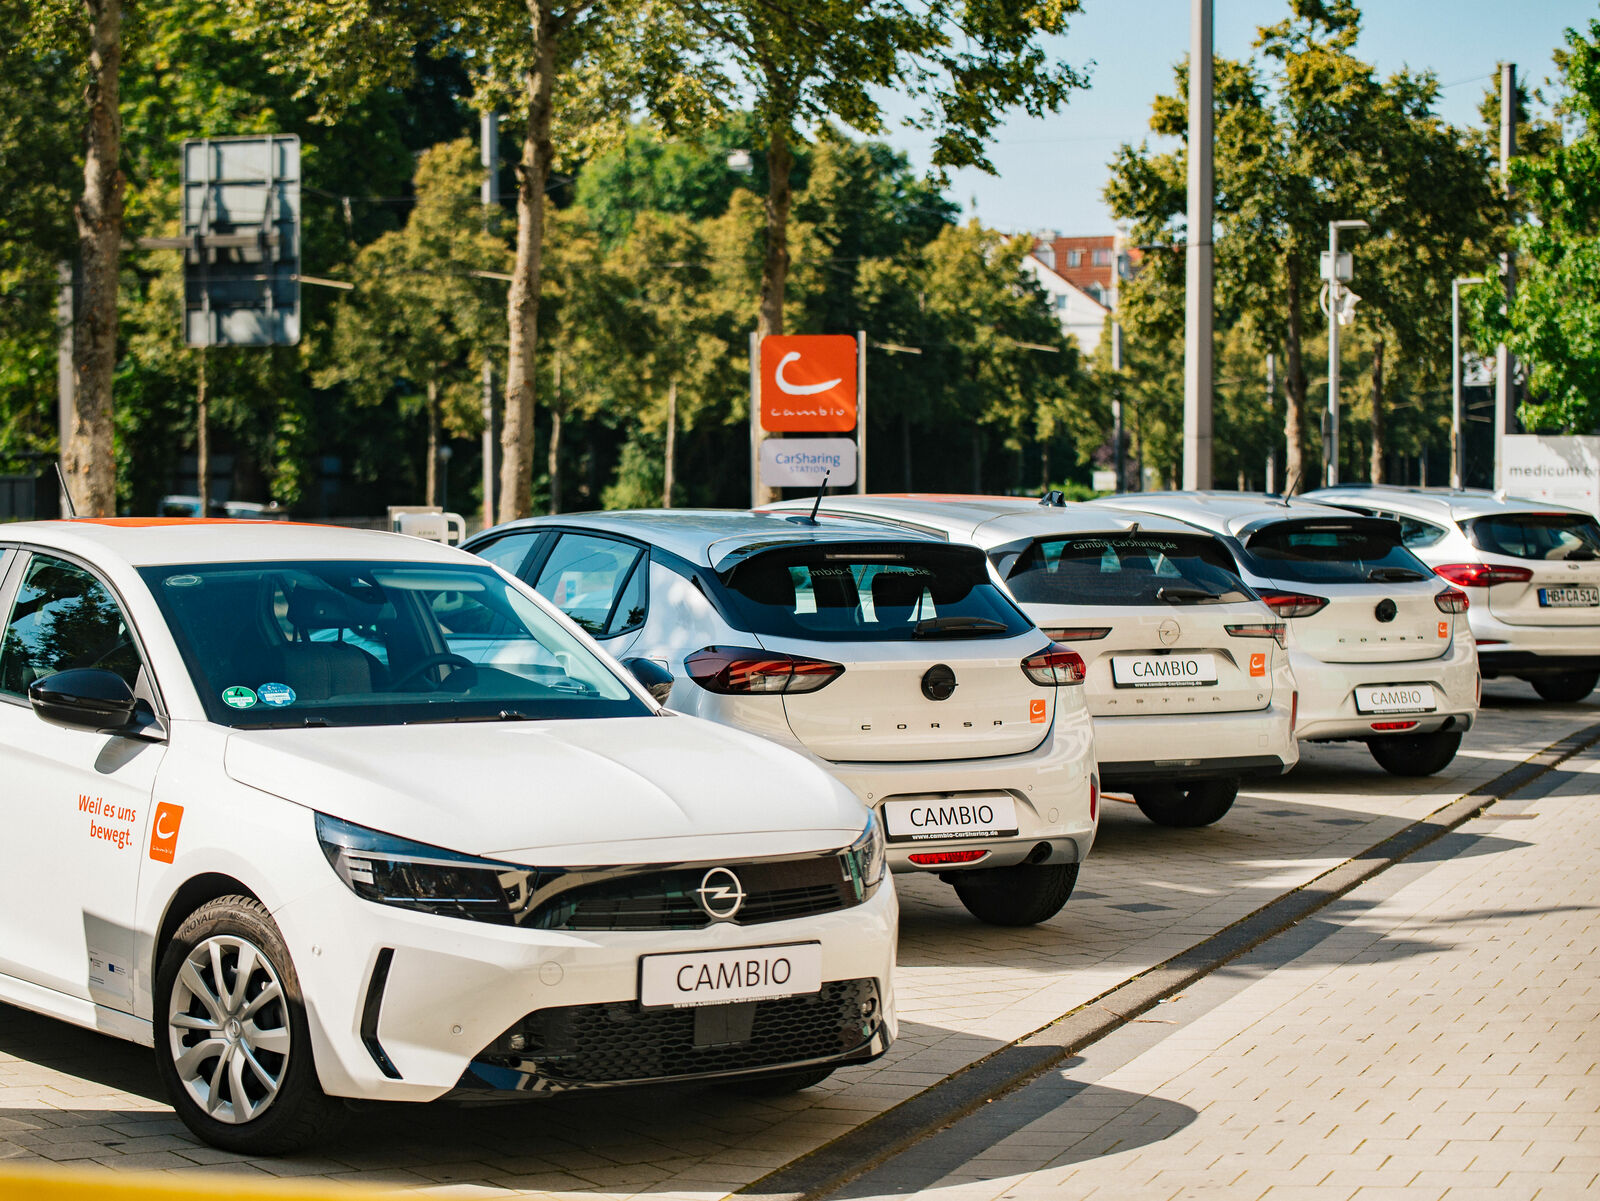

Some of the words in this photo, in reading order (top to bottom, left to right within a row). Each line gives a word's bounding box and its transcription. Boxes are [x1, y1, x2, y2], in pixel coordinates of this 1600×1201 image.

[771, 406, 845, 417] cambio
[775, 453, 841, 467] CarSharing
[1509, 465, 1580, 477] medicum
[1132, 660, 1199, 677] CAMBIO
[234, 687, 244, 697] 4
[1371, 690, 1421, 705] CAMBIO
[860, 719, 1003, 731] CORSA
[78, 794, 103, 815] Weil
[103, 803, 115, 818] es
[117, 806, 137, 823] uns
[909, 805, 994, 827] CAMBIO
[90, 819, 133, 850] bewegt.
[676, 957, 792, 992] CAMBIO
